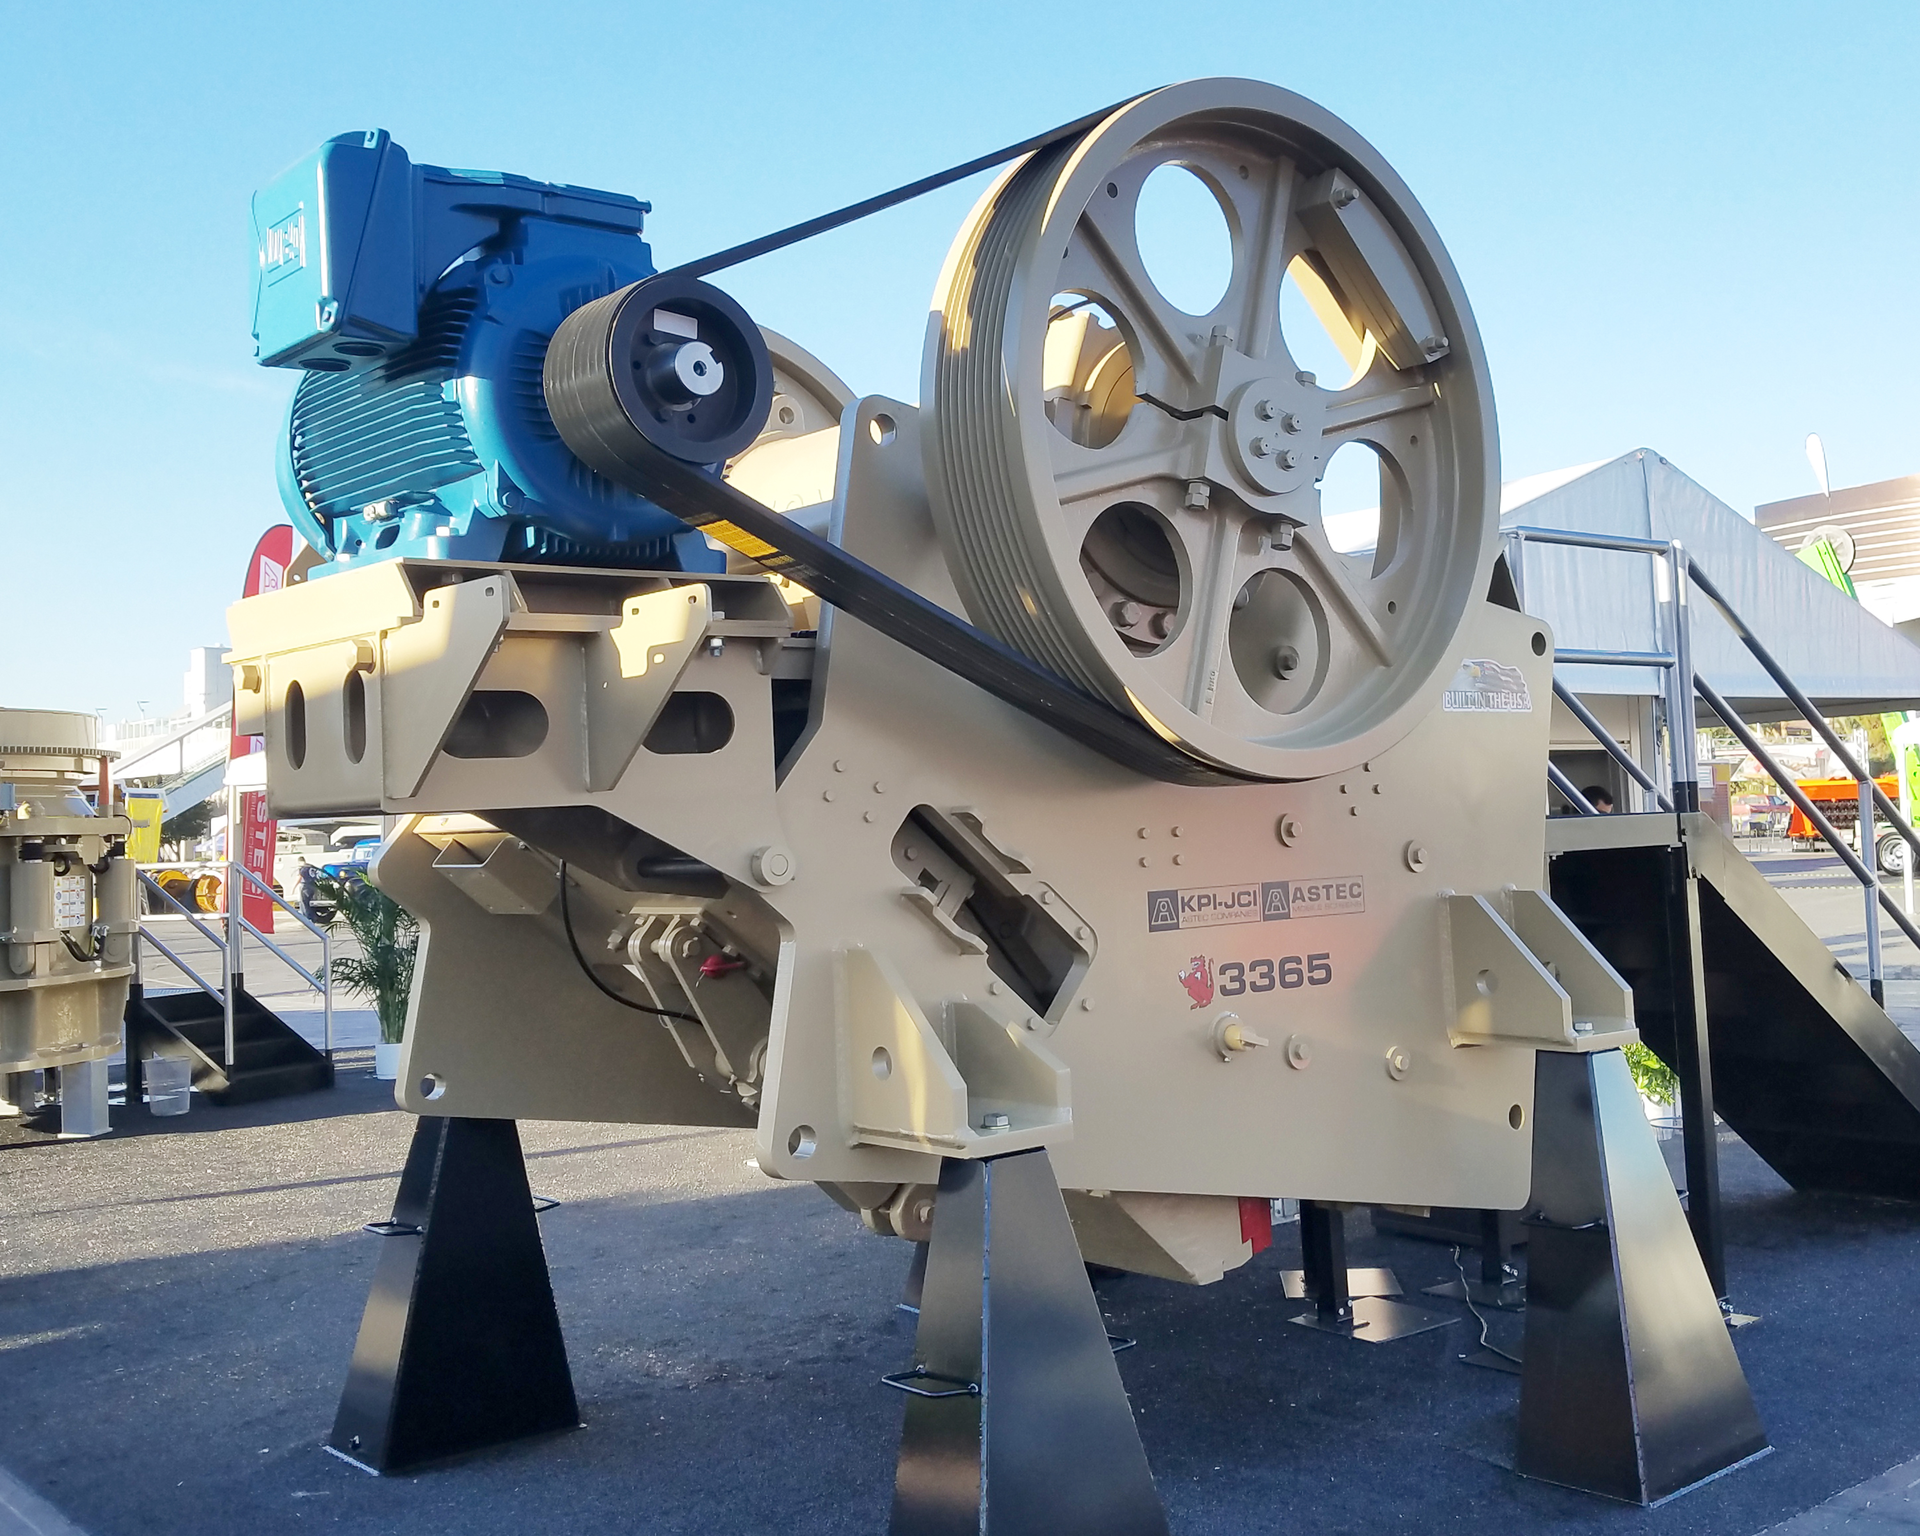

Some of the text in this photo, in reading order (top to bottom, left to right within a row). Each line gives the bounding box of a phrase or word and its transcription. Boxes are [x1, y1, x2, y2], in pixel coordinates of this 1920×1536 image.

[1444, 691, 1531, 709] BUILT IN THE USA
[1181, 889, 1257, 913] KPI-JCI
[1292, 882, 1362, 903] ASTEC
[1181, 912, 1209, 924] ASTEC
[1219, 953, 1333, 997] 3365
